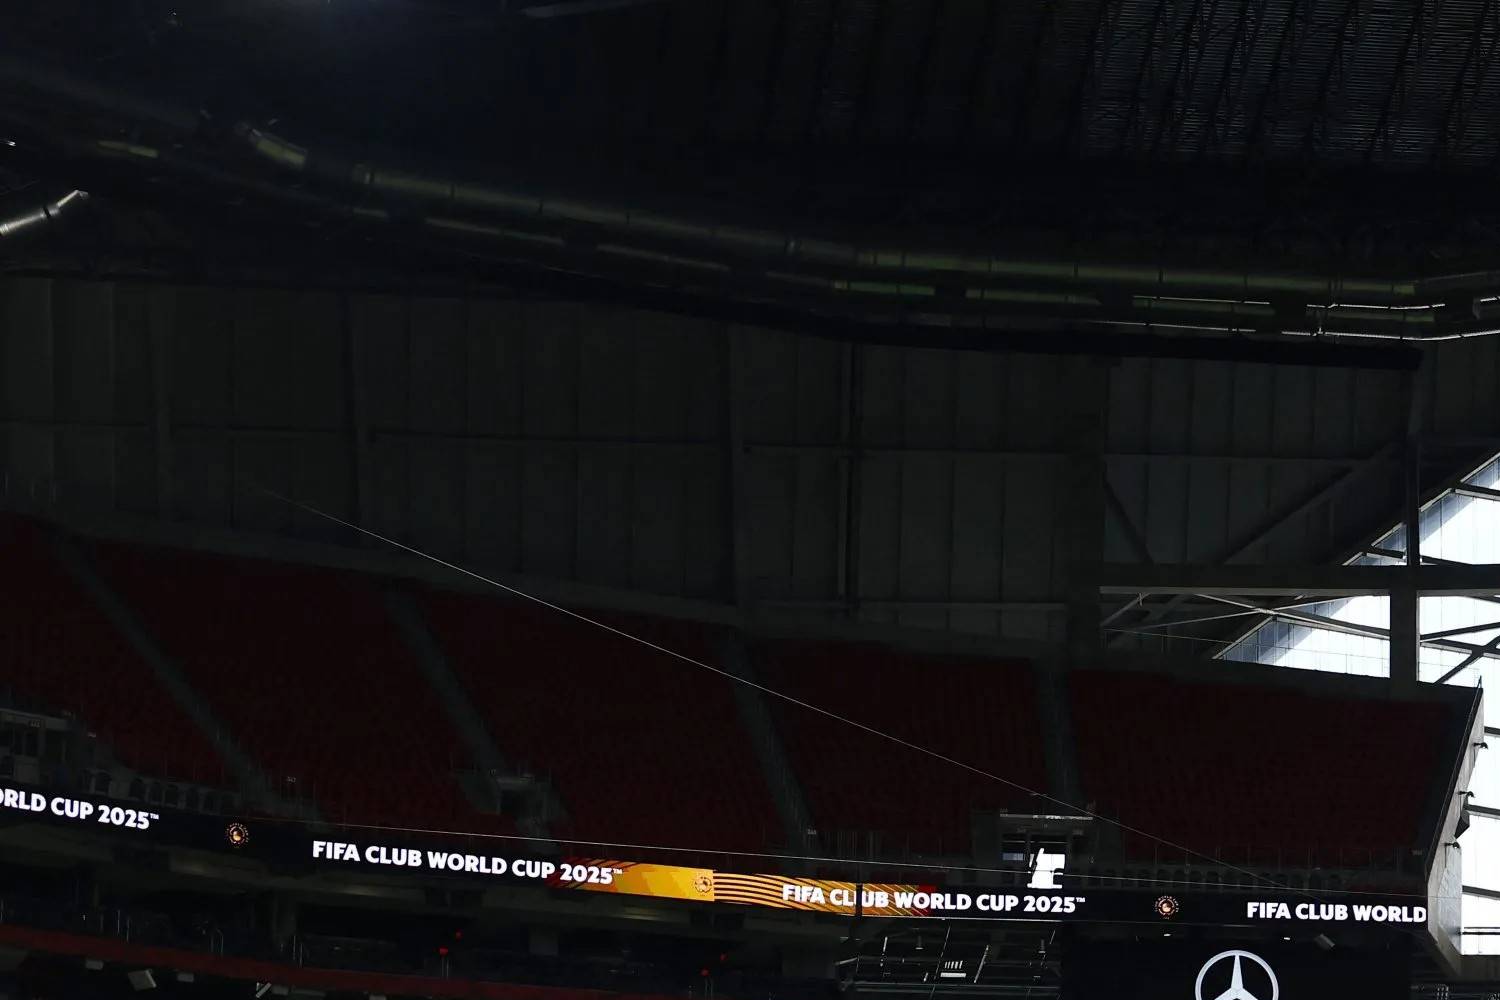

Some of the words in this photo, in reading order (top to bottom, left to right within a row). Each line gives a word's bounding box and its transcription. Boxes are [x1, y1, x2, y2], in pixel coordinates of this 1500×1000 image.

[51, 798, 94, 820] CUP
[313, 841, 361, 862] FIFA
[365, 846, 422, 867] CLUB
[427, 851, 507, 875] WORLD
[511, 859, 556, 879] CUP
[782, 884, 826, 905] FIFA
[829, 889, 889, 908] CLUB
[893, 891, 971, 911] WORLD
[976, 895, 1019, 912] CUP
[1247, 901, 1292, 919] FIFA
[1295, 903, 1349, 921] CLUB
[1352, 904, 1426, 923] WORLD
